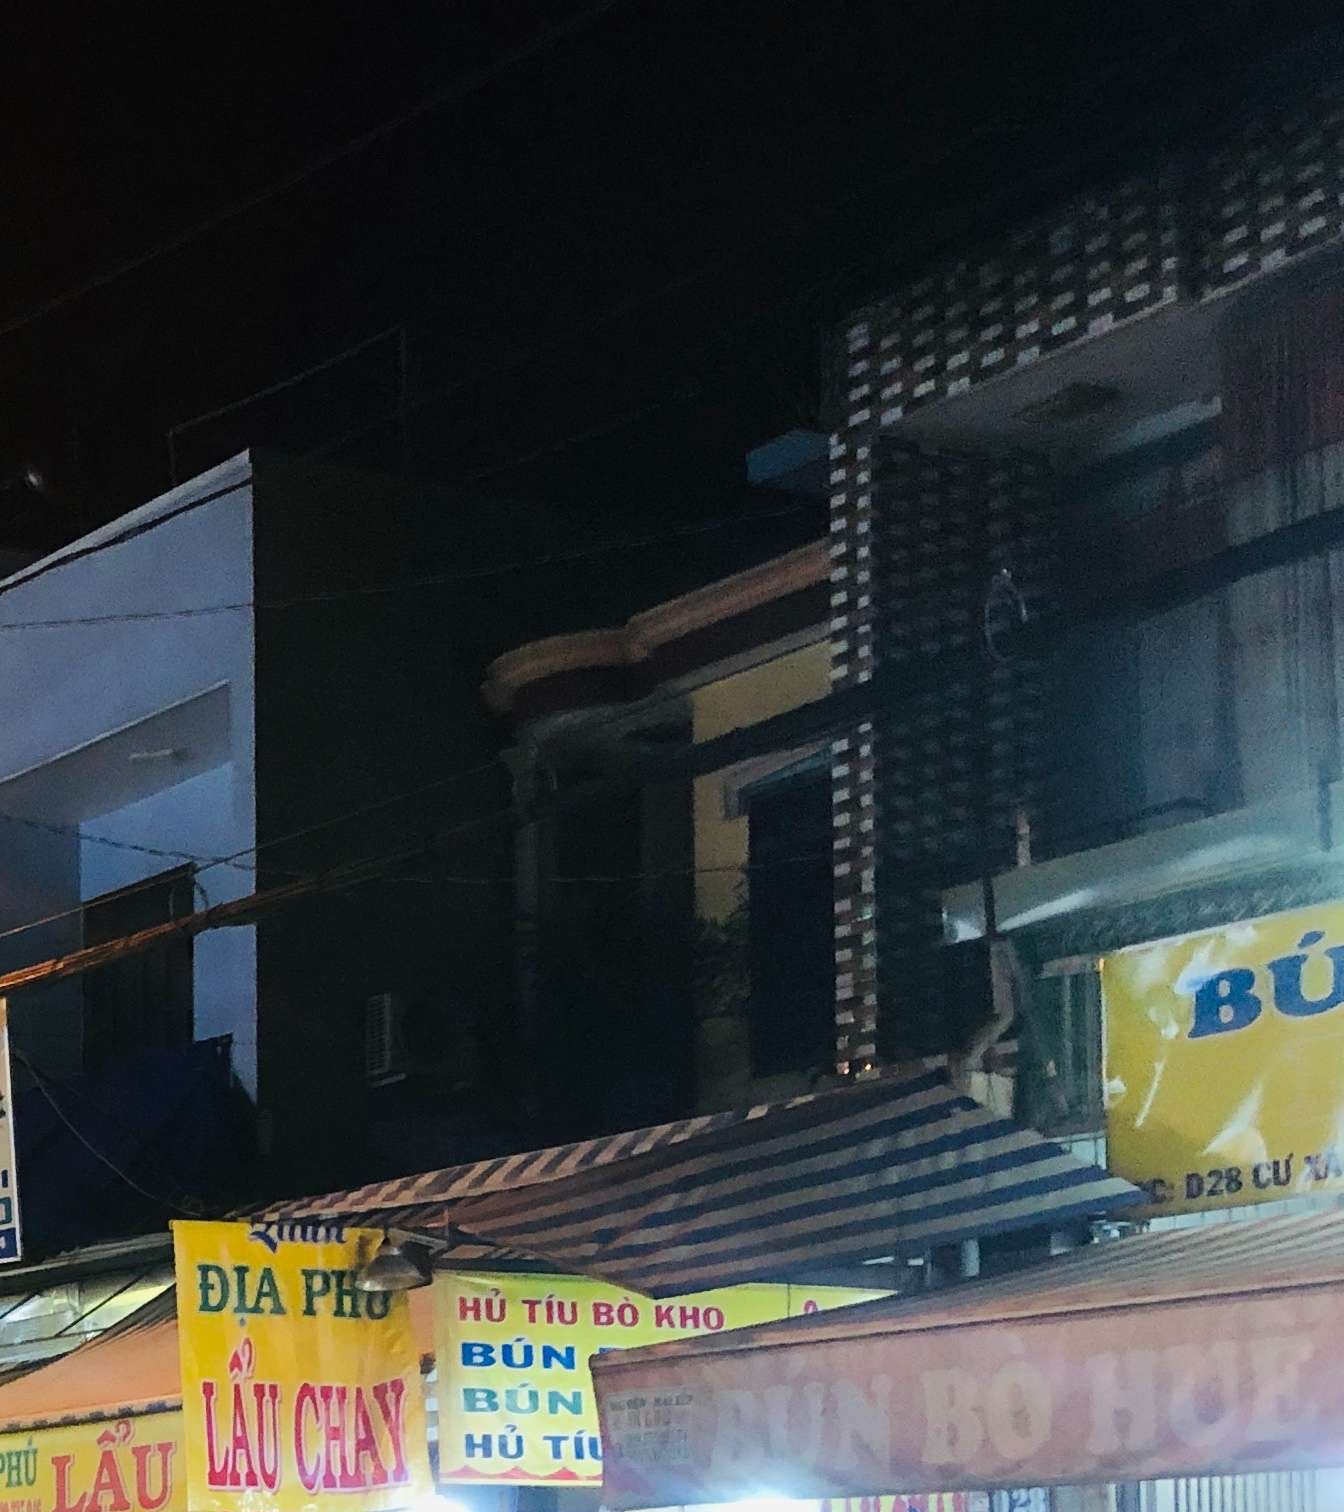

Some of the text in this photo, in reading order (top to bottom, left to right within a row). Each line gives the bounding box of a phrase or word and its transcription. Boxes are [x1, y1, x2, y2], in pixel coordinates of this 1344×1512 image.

[1184, 1166, 1243, 1200] D28
[197, 1264, 287, 1327] ĐỊA
[458, 1288, 725, 1331] HỦ TÍU BÒ KHO
[460, 1338, 576, 1370] BÚN
[202, 1337, 410, 1491] LẨU CHAY
[462, 1382, 584, 1415] BÚN
[465, 1424, 525, 1460] HỦ
